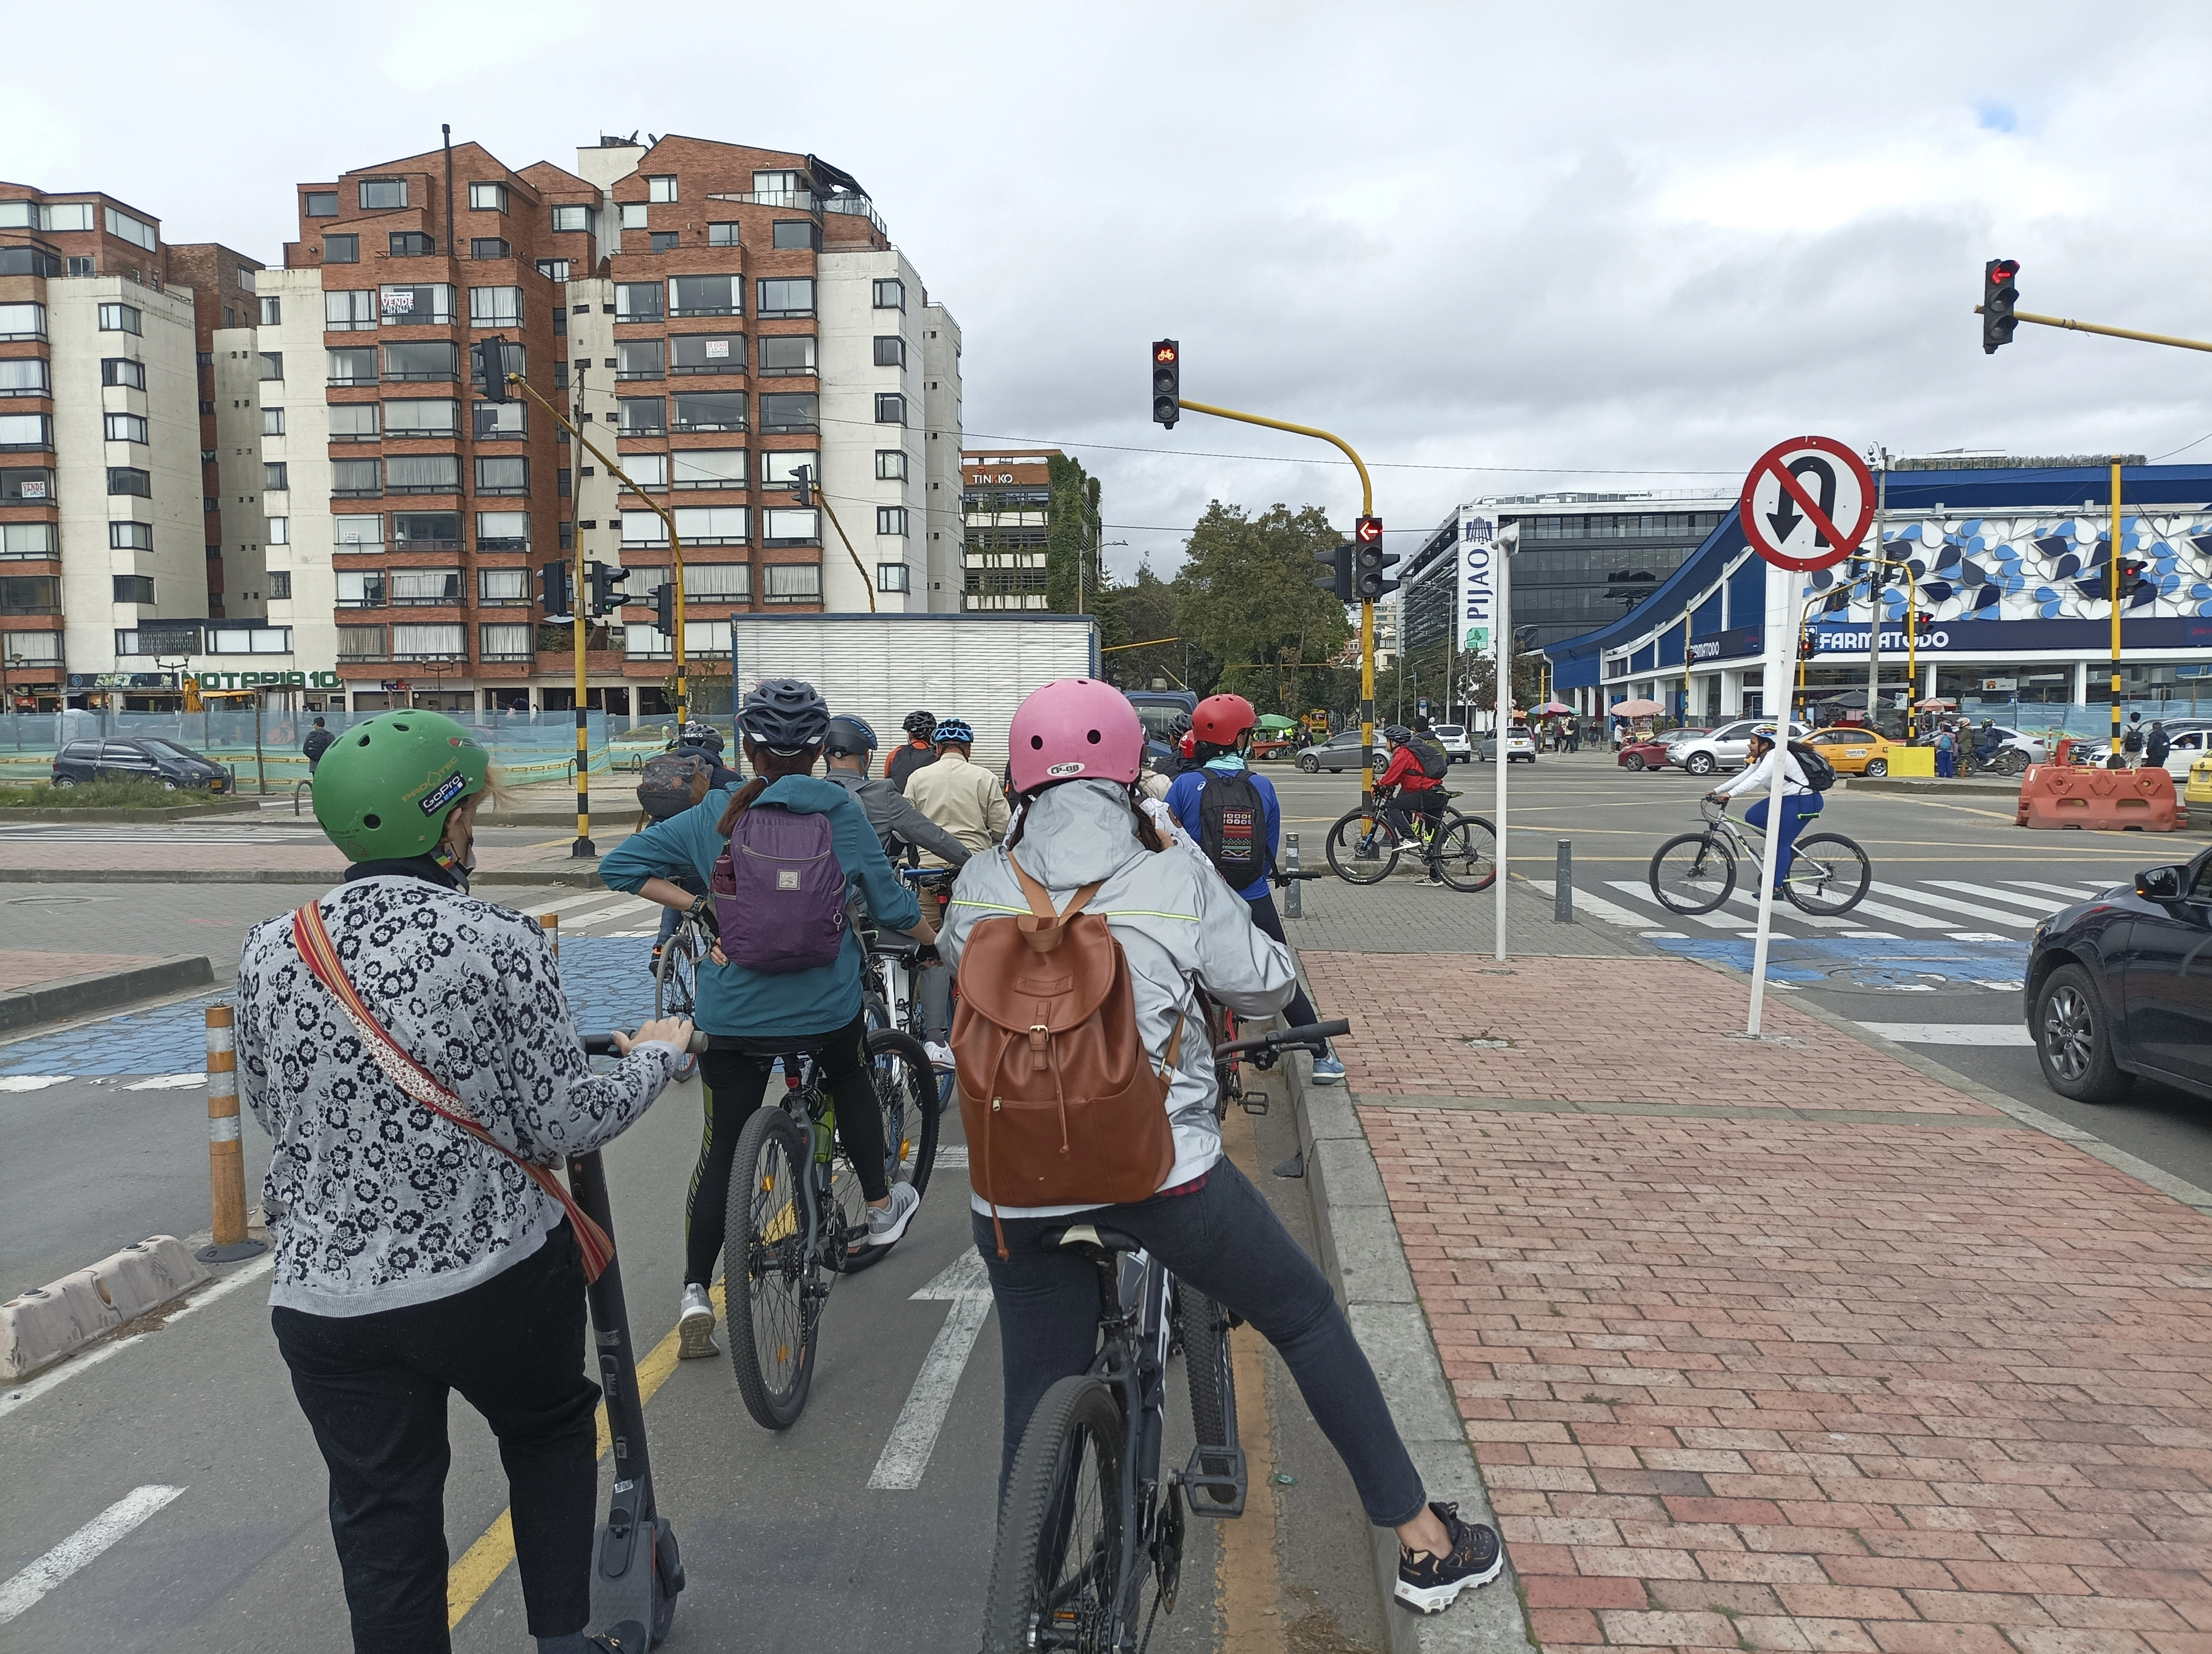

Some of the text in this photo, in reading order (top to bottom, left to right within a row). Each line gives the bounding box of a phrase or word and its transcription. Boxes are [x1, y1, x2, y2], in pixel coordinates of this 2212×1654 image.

[23, 483, 44, 491] VENDE
[972, 474, 1013, 484] TINKKO
[1467, 548, 1493, 619] PIJAO
[422, 776, 460, 808] GoPro
